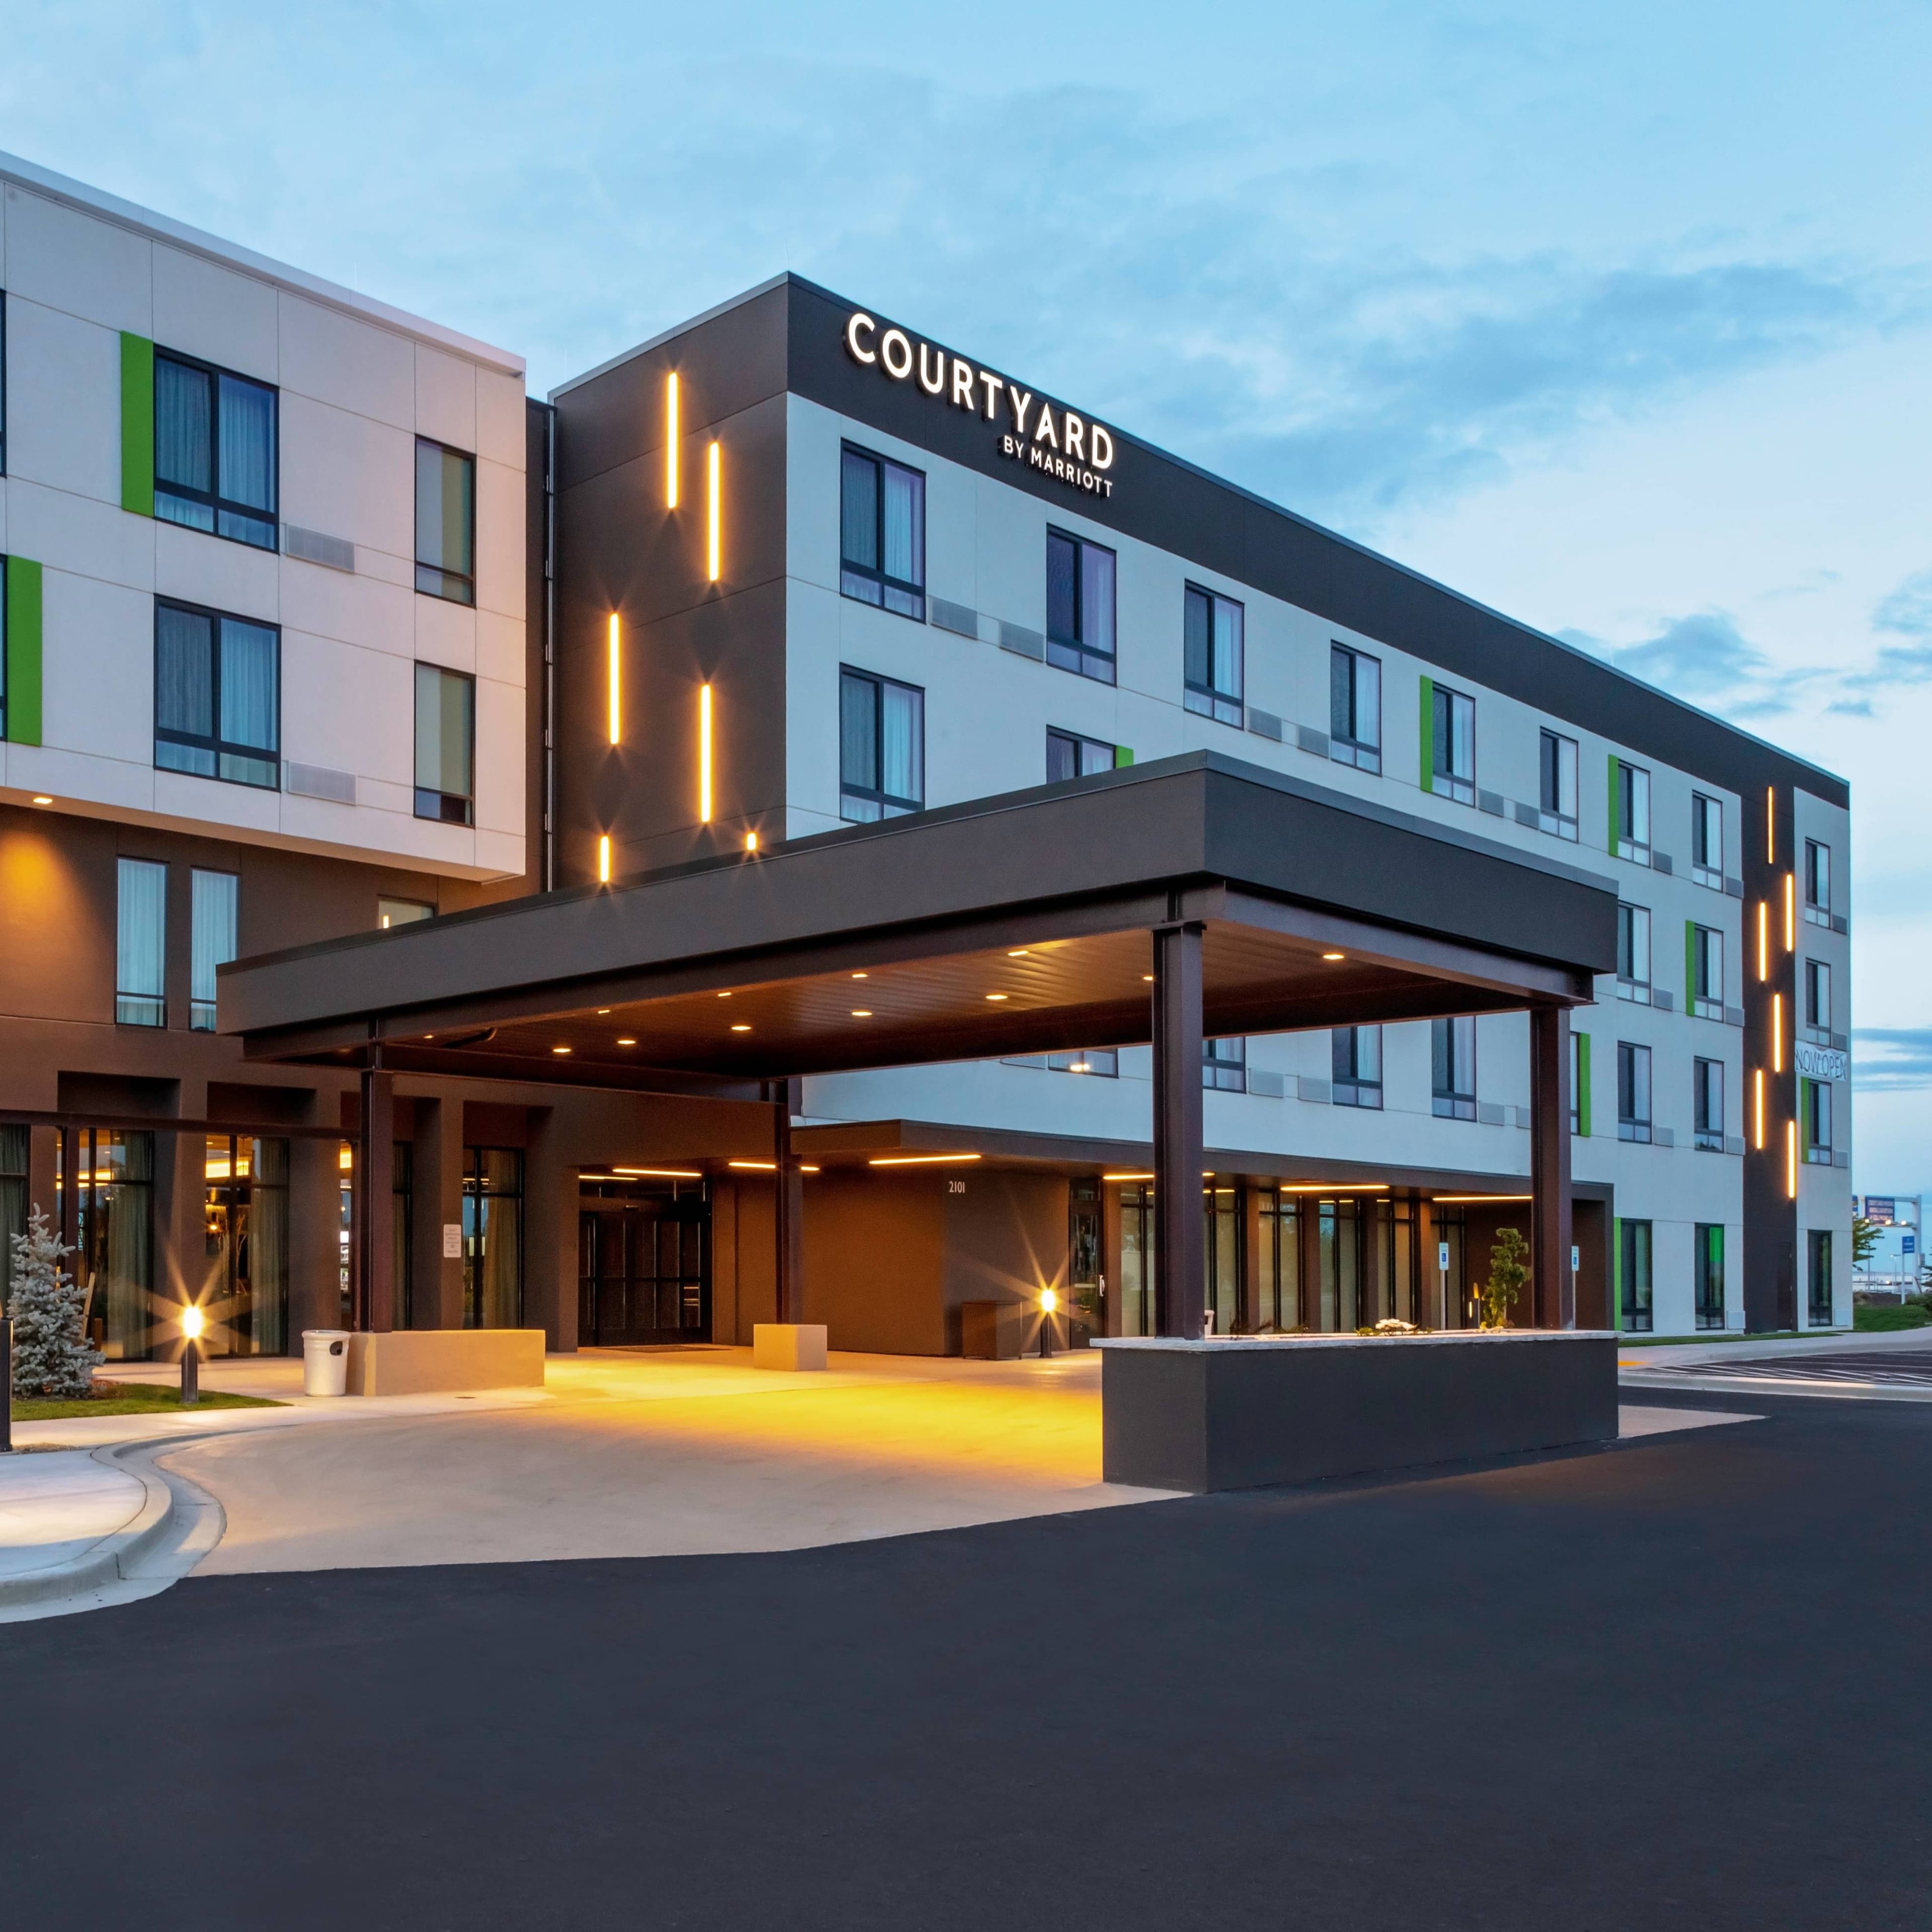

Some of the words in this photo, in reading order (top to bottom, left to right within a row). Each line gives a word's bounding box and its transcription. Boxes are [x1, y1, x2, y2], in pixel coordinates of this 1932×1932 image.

[848, 312, 1113, 469] COURTYARD
[1004, 435, 1024, 459] BY
[1031, 447, 1112, 497] MARRIOTT
[1795, 1049, 1820, 1075] NOW
[1822, 1054, 1846, 1080] OPEN
[949, 1181, 965, 1193] 2101
